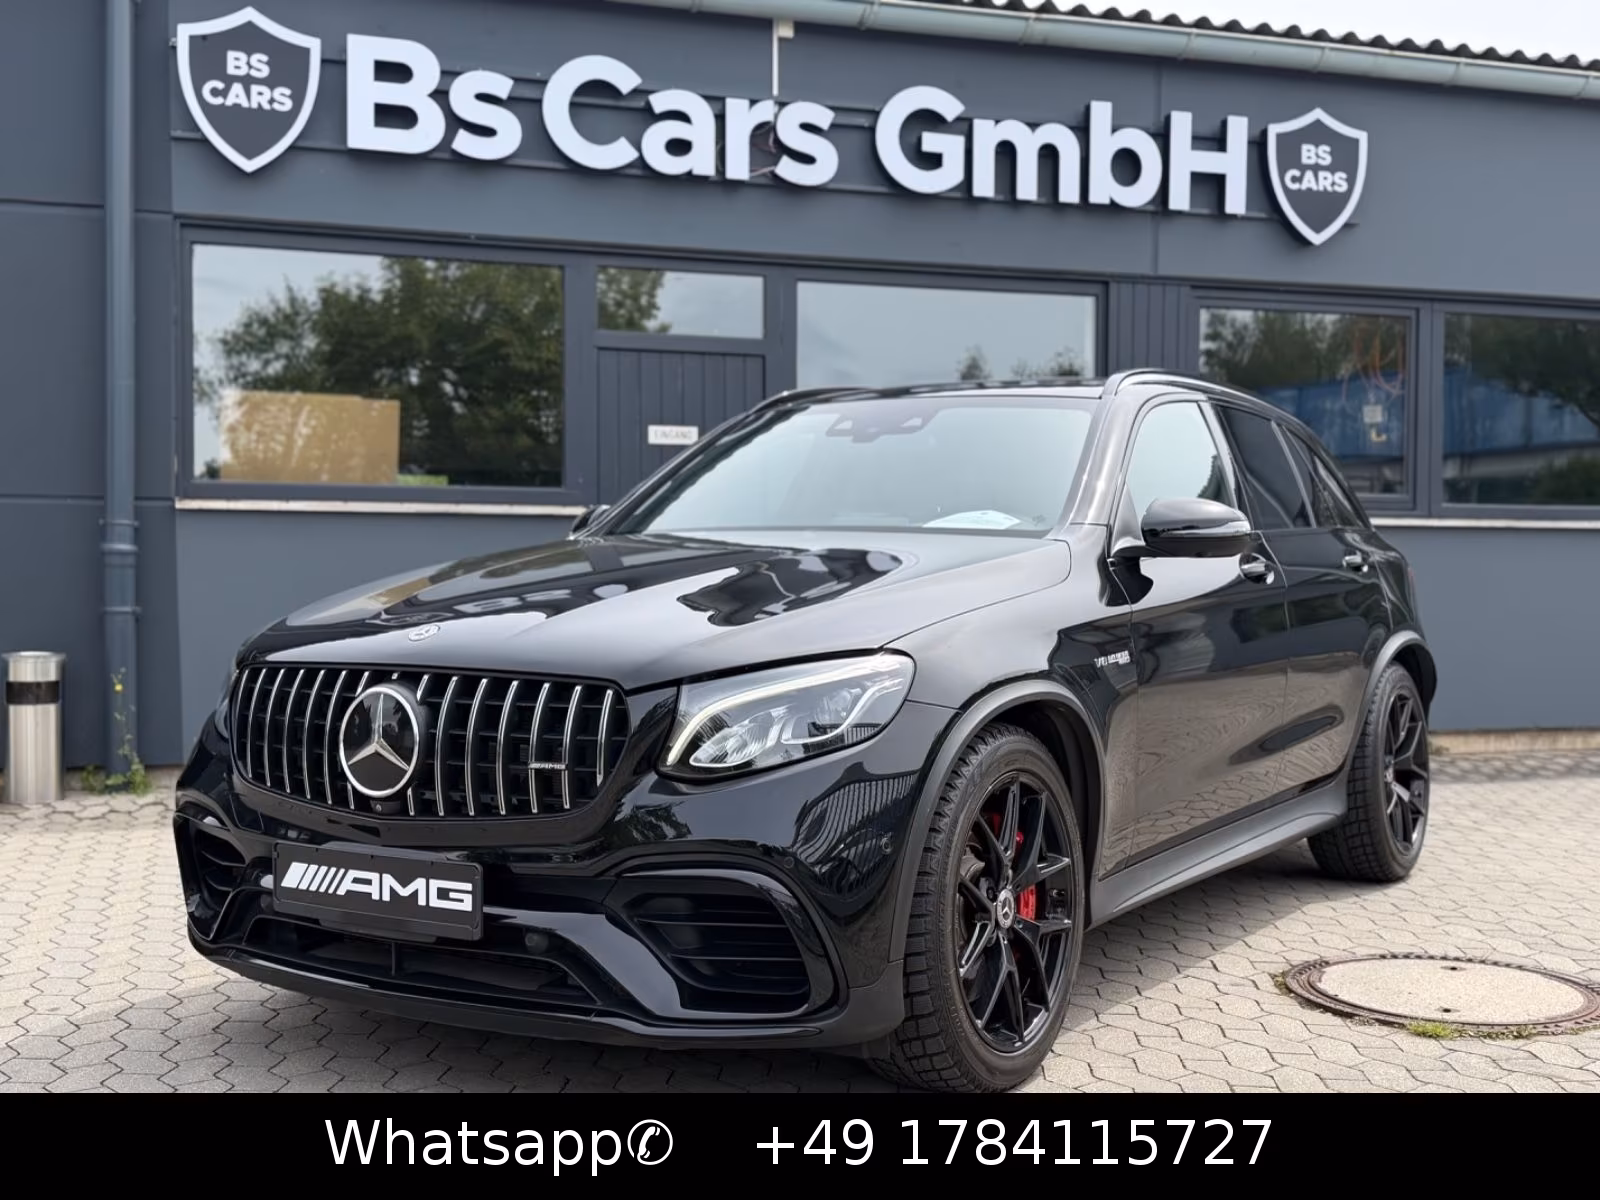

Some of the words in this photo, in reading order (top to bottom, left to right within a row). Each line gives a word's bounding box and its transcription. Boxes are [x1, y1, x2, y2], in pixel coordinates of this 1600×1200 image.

[226, 50, 271, 79] BS
[201, 79, 294, 112] CARS
[346, 33, 522, 160] Bs
[542, 55, 839, 186] Cars
[875, 85, 1248, 215] GmbH
[1300, 143, 1333, 166] BS
[1284, 168, 1349, 193] CARS
